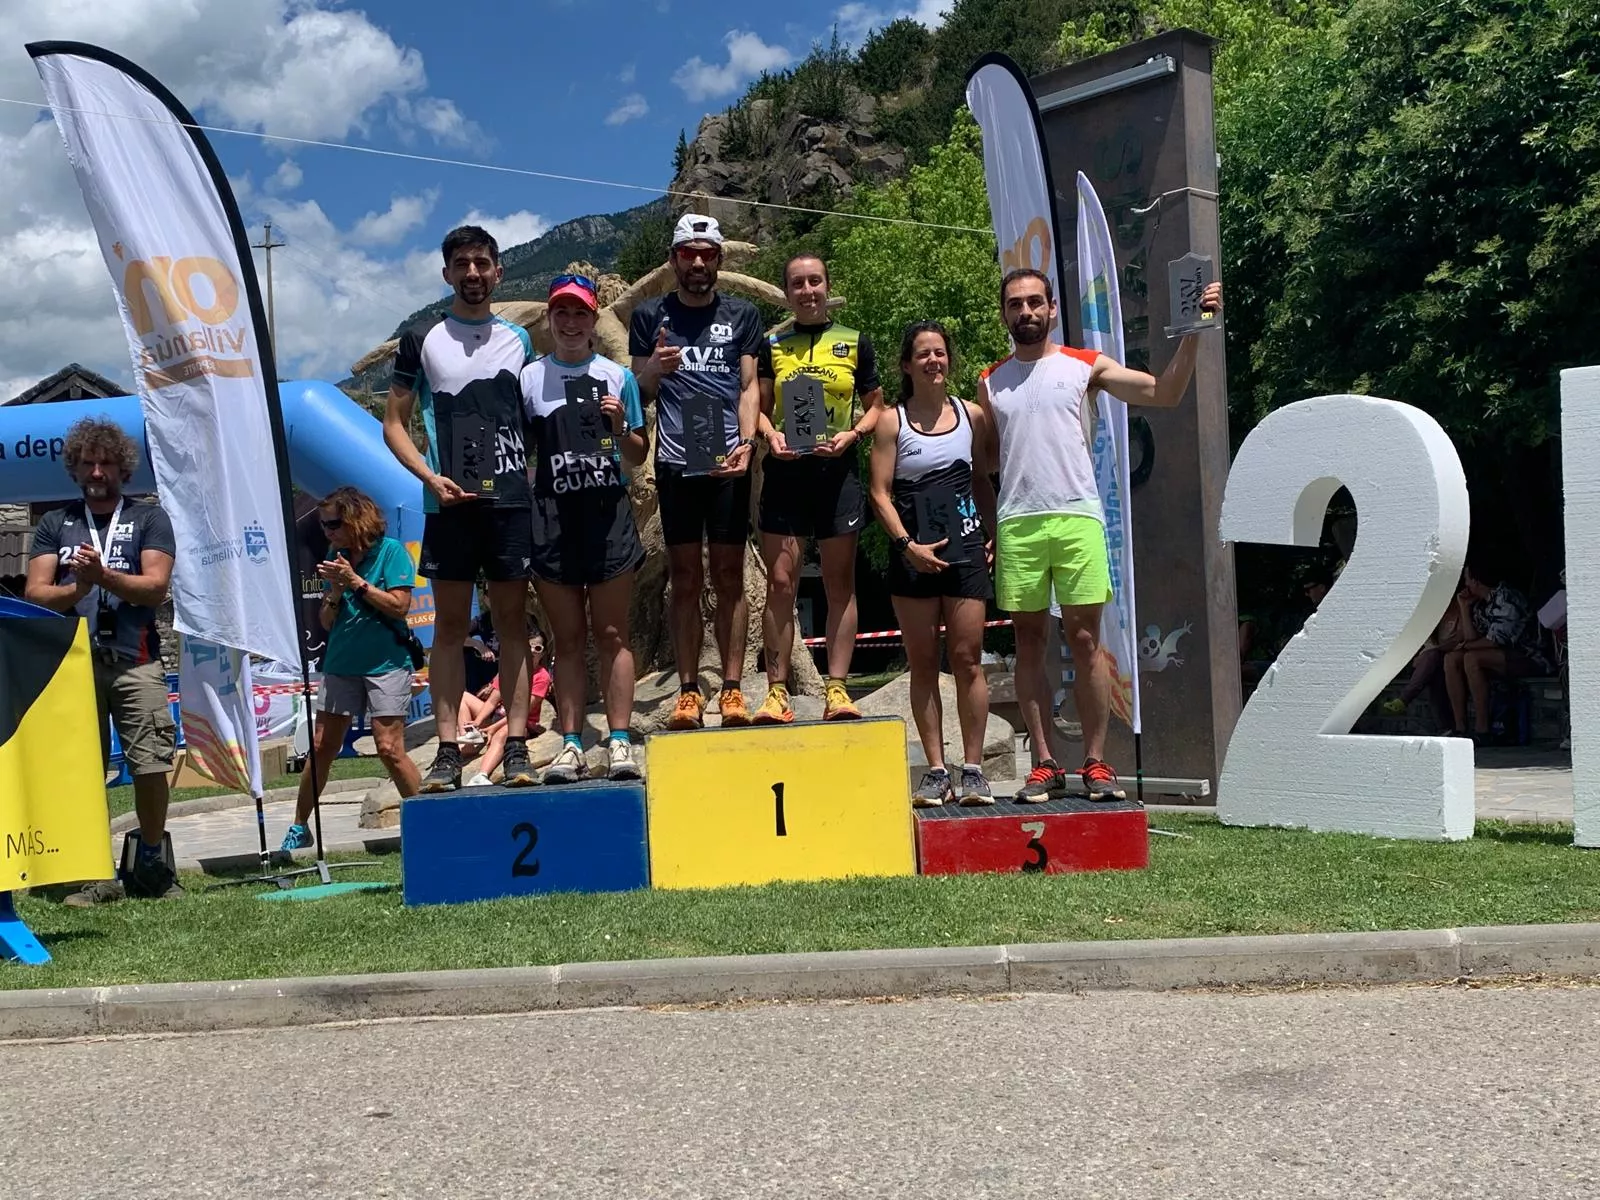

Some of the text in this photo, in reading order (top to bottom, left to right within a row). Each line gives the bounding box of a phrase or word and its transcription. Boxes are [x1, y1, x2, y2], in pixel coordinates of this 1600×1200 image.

[710, 323, 733, 336] on
[678, 362, 730, 373] collarada
[793, 396, 811, 436] 2KV
[15, 434, 65, 461] dep
[553, 470, 619, 494] GUARA
[1218, 394, 1475, 842] 2
[771, 782, 787, 836] 1
[7, 825, 59, 859] MÁS...
[510, 822, 540, 878] 2
[1021, 821, 1048, 873] 3
